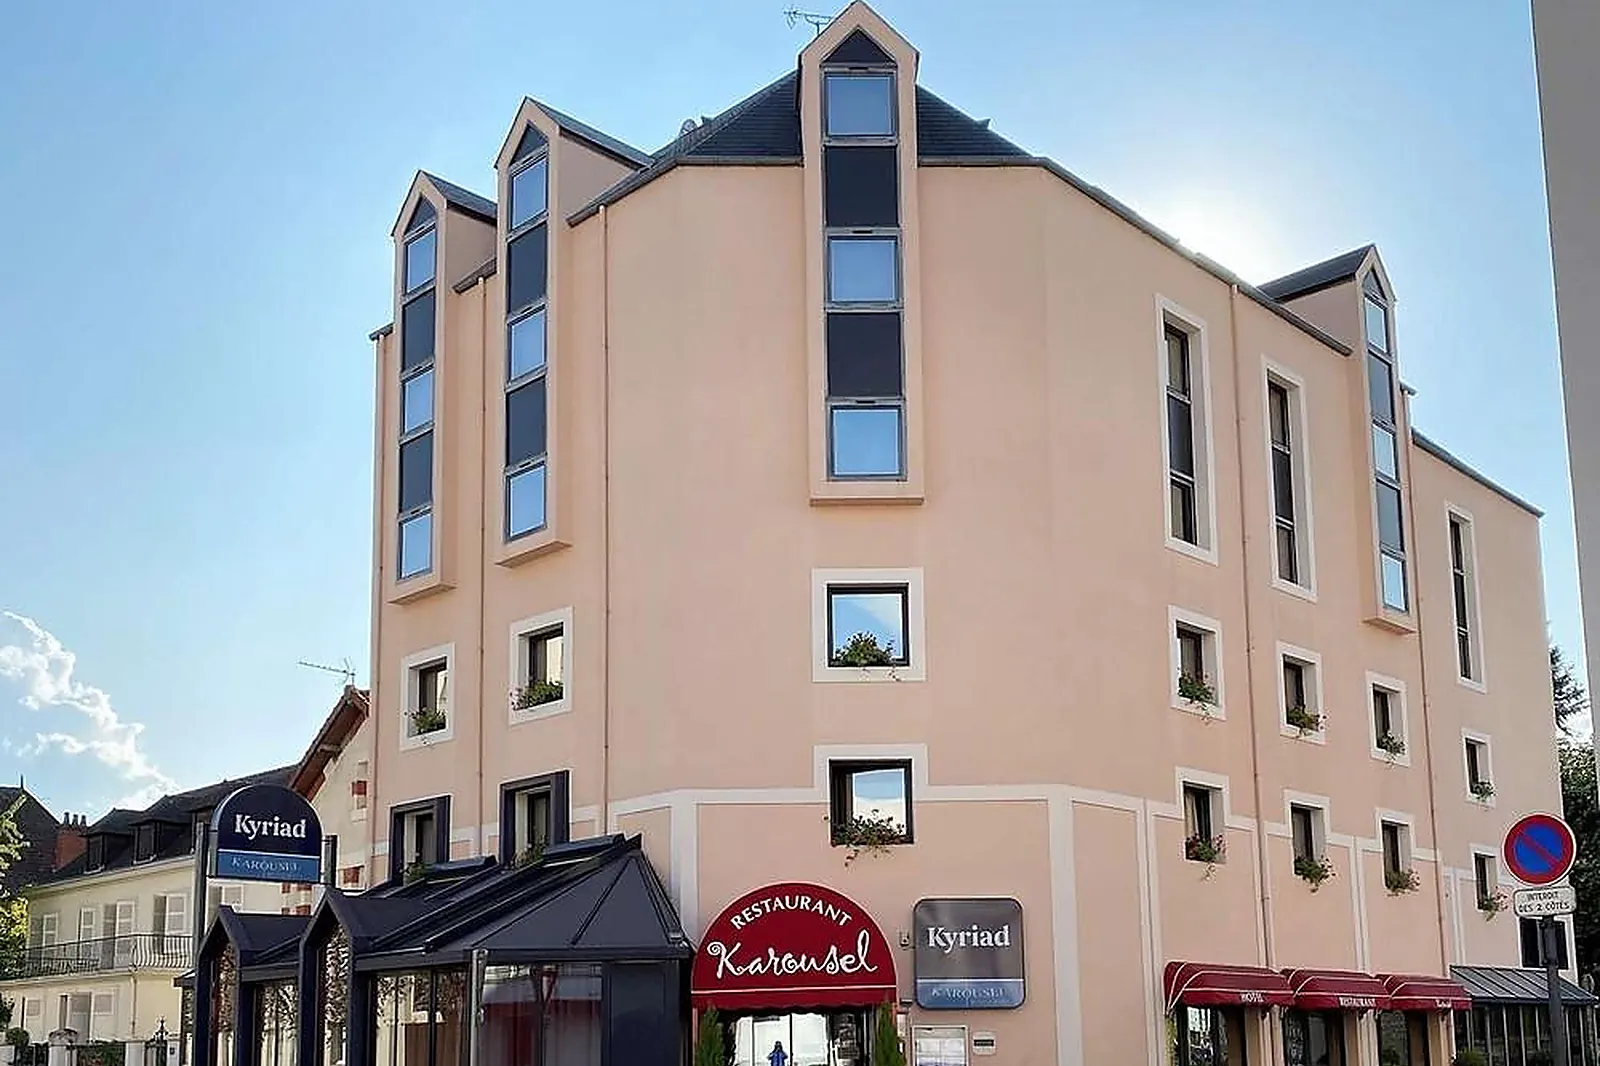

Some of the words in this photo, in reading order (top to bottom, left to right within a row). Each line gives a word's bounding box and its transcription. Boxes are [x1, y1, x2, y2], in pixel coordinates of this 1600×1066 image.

[235, 814, 307, 840] Kyriad
[731, 895, 852, 930] RESTAURANT
[707, 929, 878, 979] Karousel
[927, 925, 1010, 954] Kyriad
